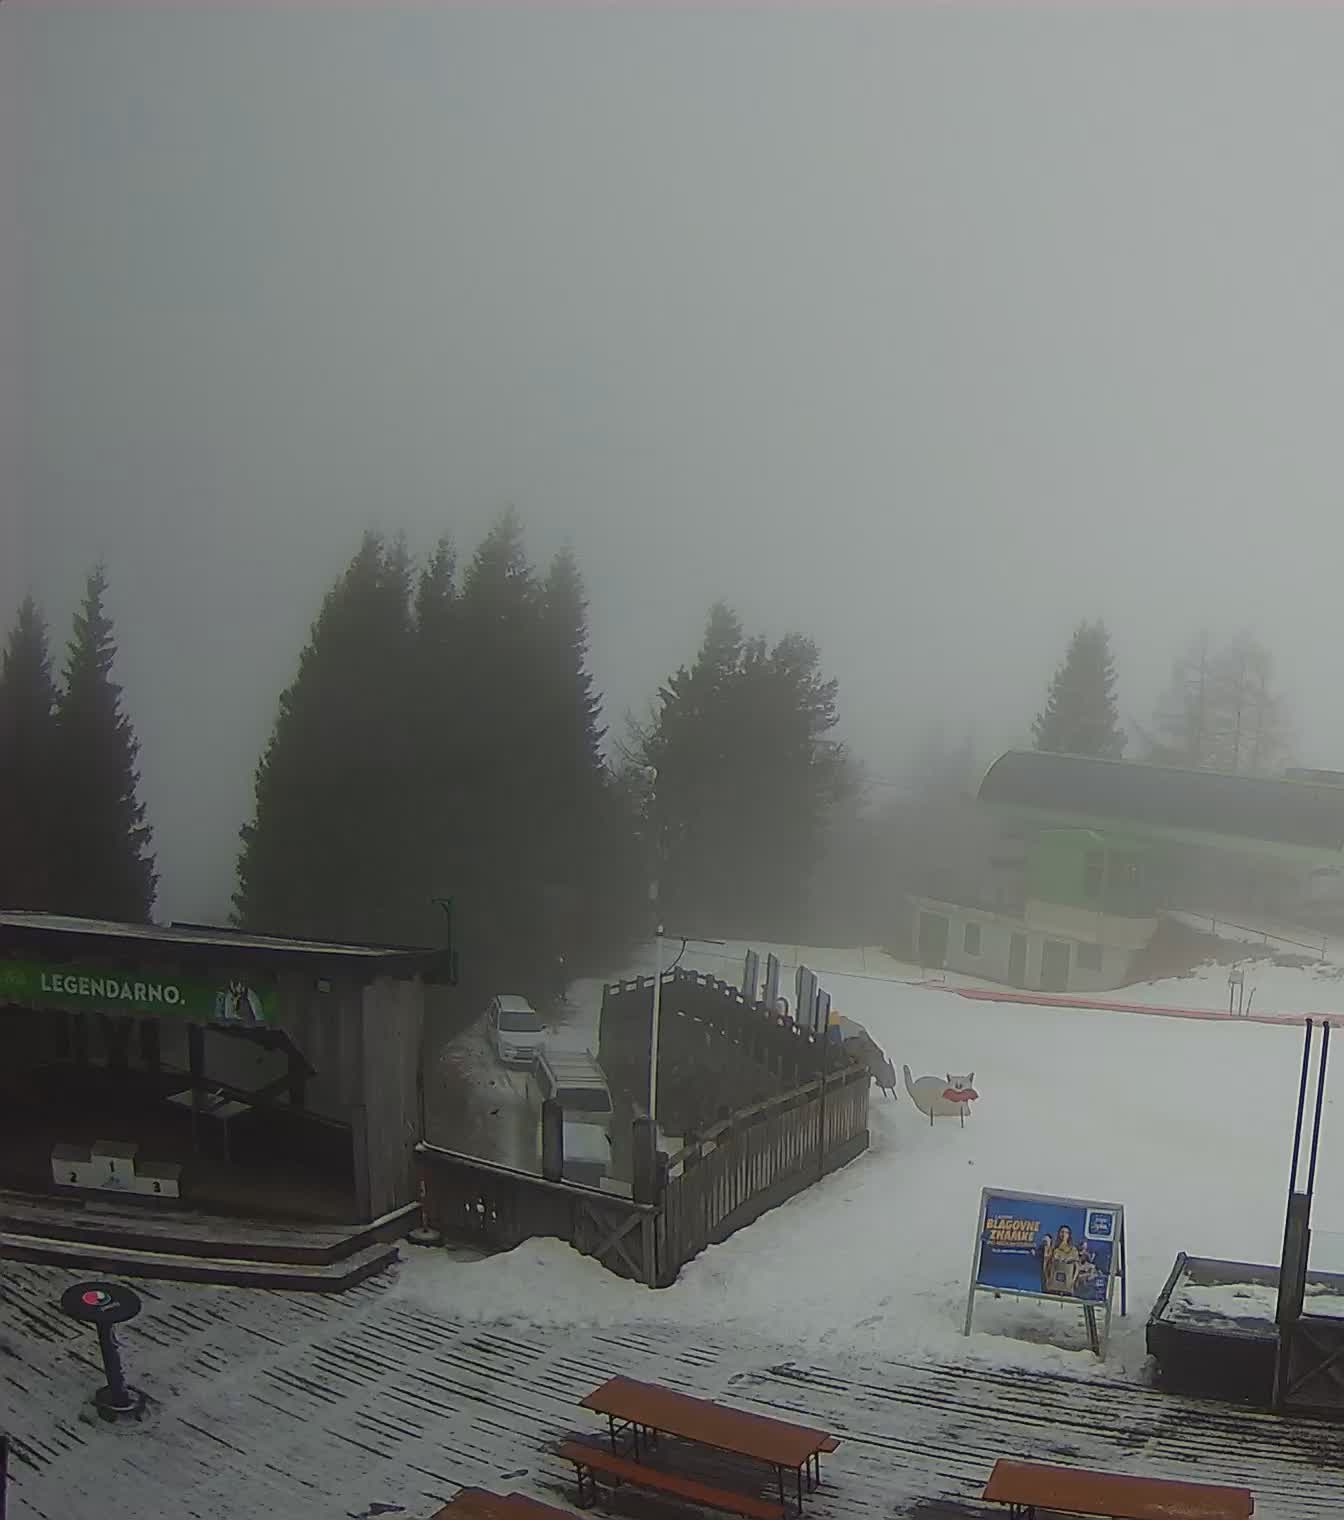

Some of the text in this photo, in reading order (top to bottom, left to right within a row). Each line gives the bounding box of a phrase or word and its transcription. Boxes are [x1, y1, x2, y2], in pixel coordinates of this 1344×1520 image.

[40, 973, 186, 1005] LEGENDARNO.
[69, 1171, 77, 1183] 2
[152, 1181, 161, 1193] 3
[986, 1218, 1041, 1232] BLAGOVNE
